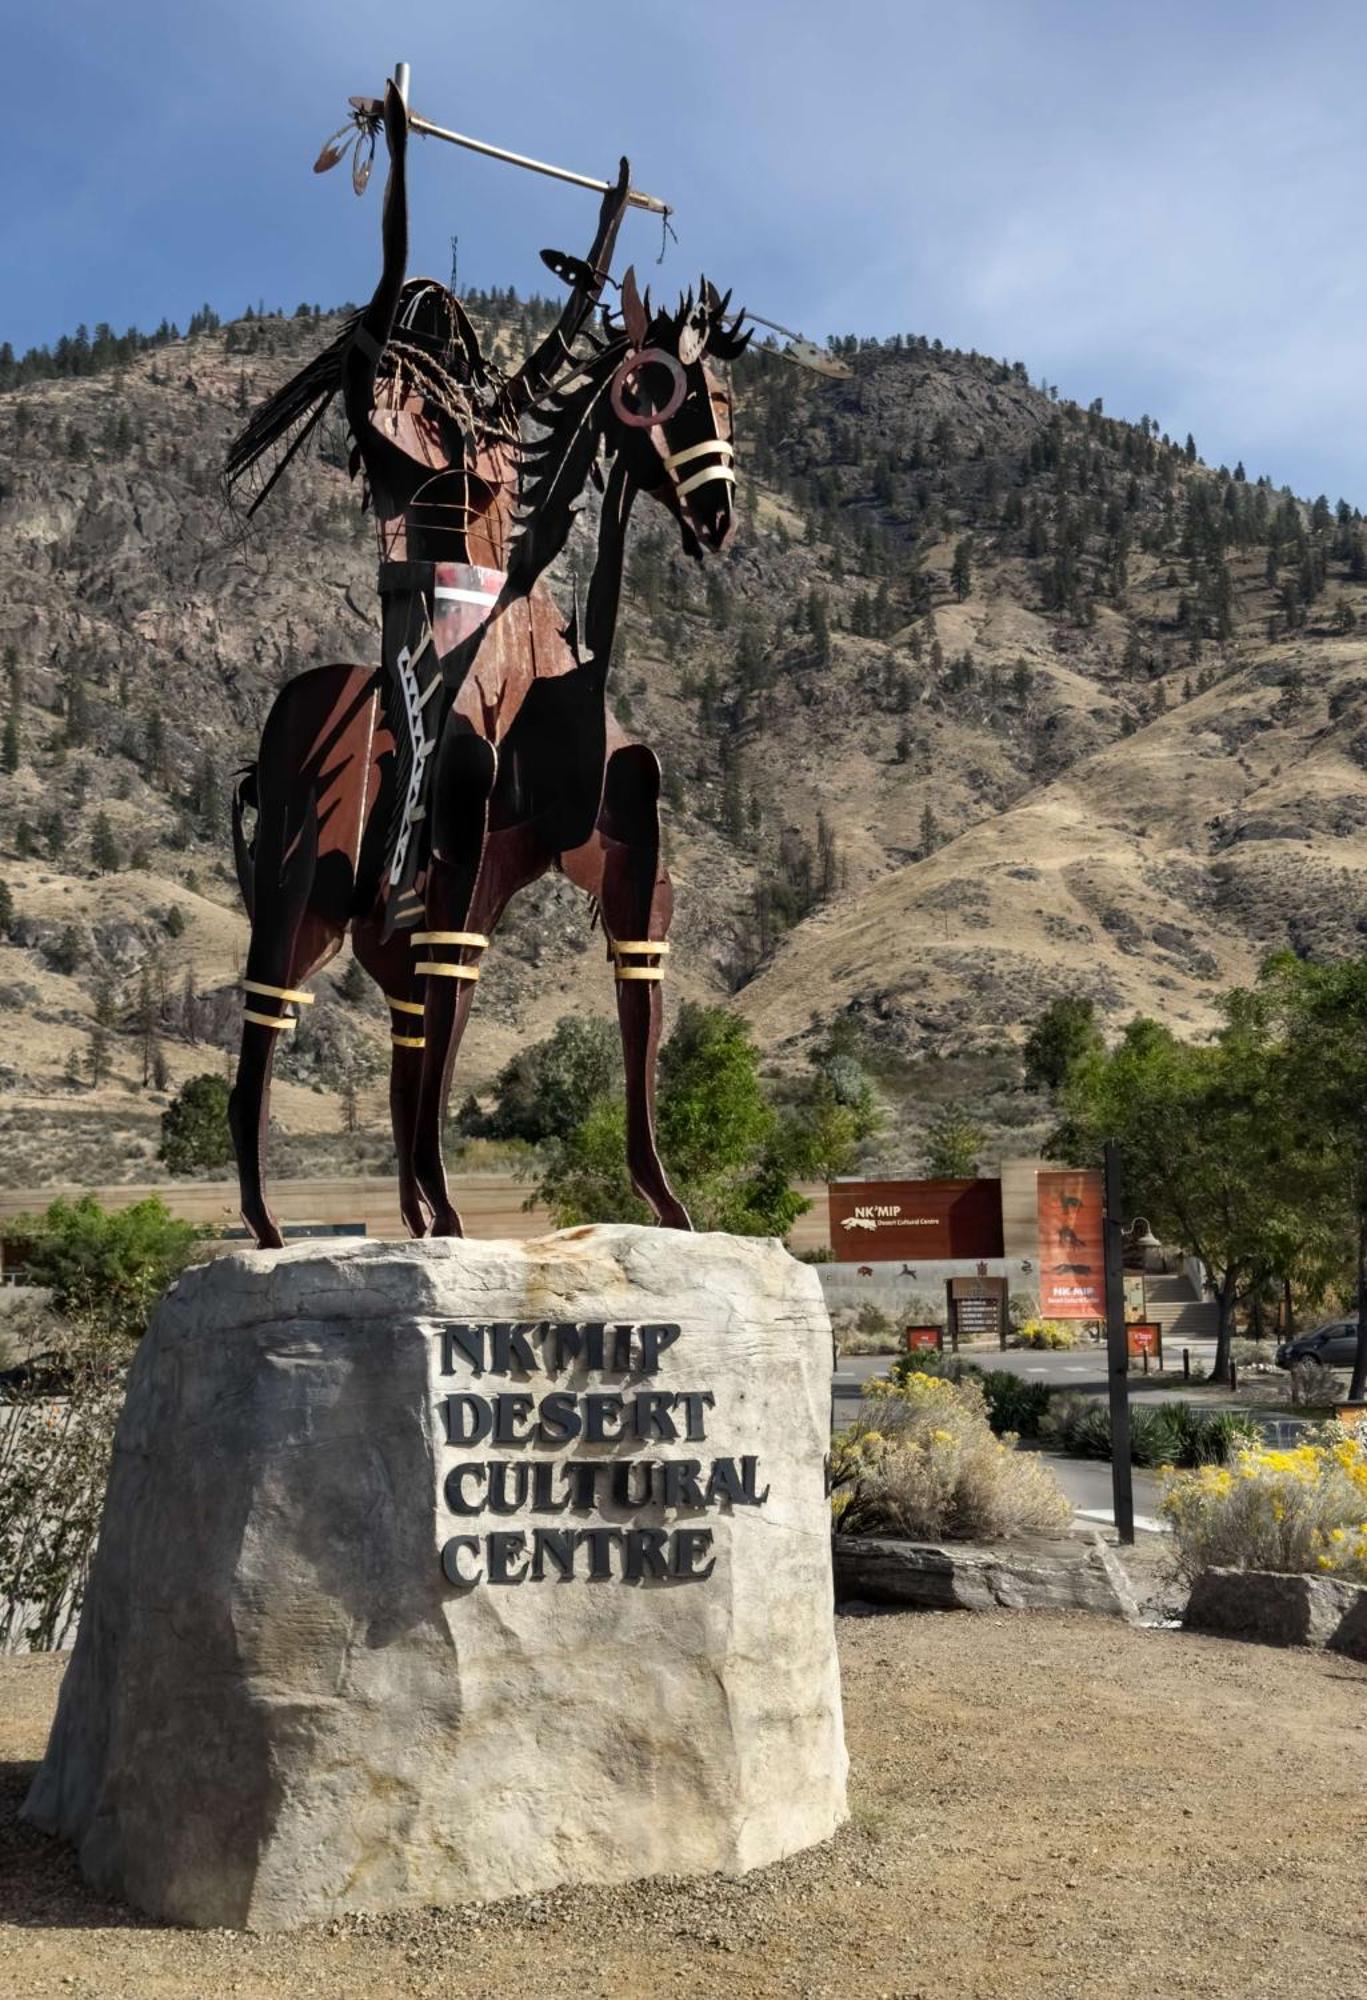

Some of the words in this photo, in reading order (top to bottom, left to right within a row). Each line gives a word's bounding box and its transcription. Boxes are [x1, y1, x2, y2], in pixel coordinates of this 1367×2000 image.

[855, 1205, 901, 1218] NK'MIP
[920, 1217, 939, 1225] Centre
[440, 1322, 682, 1378] NK'MIP
[442, 1390, 714, 1446] DESERT
[444, 1455, 770, 1515] CULTURAL
[441, 1527, 717, 1588] CENTRE
